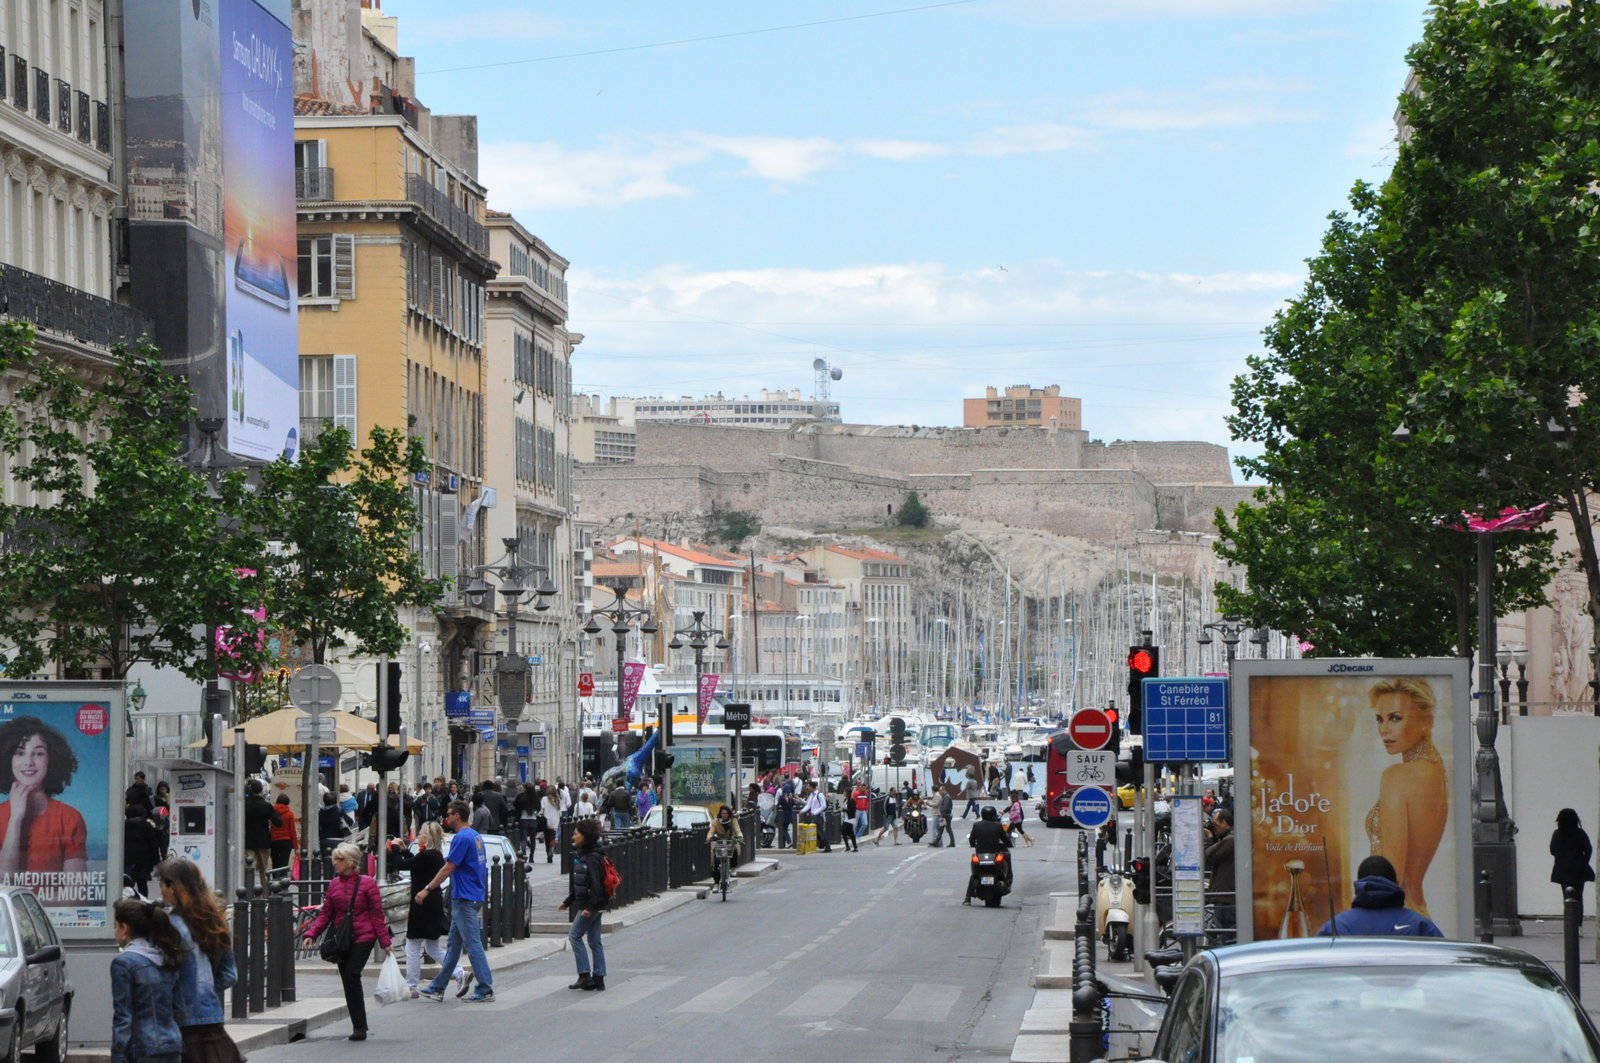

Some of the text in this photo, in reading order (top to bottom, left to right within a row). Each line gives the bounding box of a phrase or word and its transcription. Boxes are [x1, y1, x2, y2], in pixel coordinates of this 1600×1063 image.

[251, 33, 273, 87] GALAXY
[1327, 663, 1374, 673] JCDecaux
[1159, 684, 1210, 694] Canebière
[1160, 695, 1172, 706] St
[726, 711, 748, 721] Métro
[1209, 712, 1221, 722] 81
[1076, 754, 1106, 764] SAUF
[689, 770, 714, 781] GRAND
[685, 780, 712, 788] ATELIER
[1276, 815, 1318, 834] Dior
[1265, 843, 1283, 852] Voile
[1294, 843, 1324, 852] Parfum
[14, 871, 106, 886] MÉDITERRANÉE
[38, 886, 55, 901] AU
[58, 886, 106, 901] MUCEM
